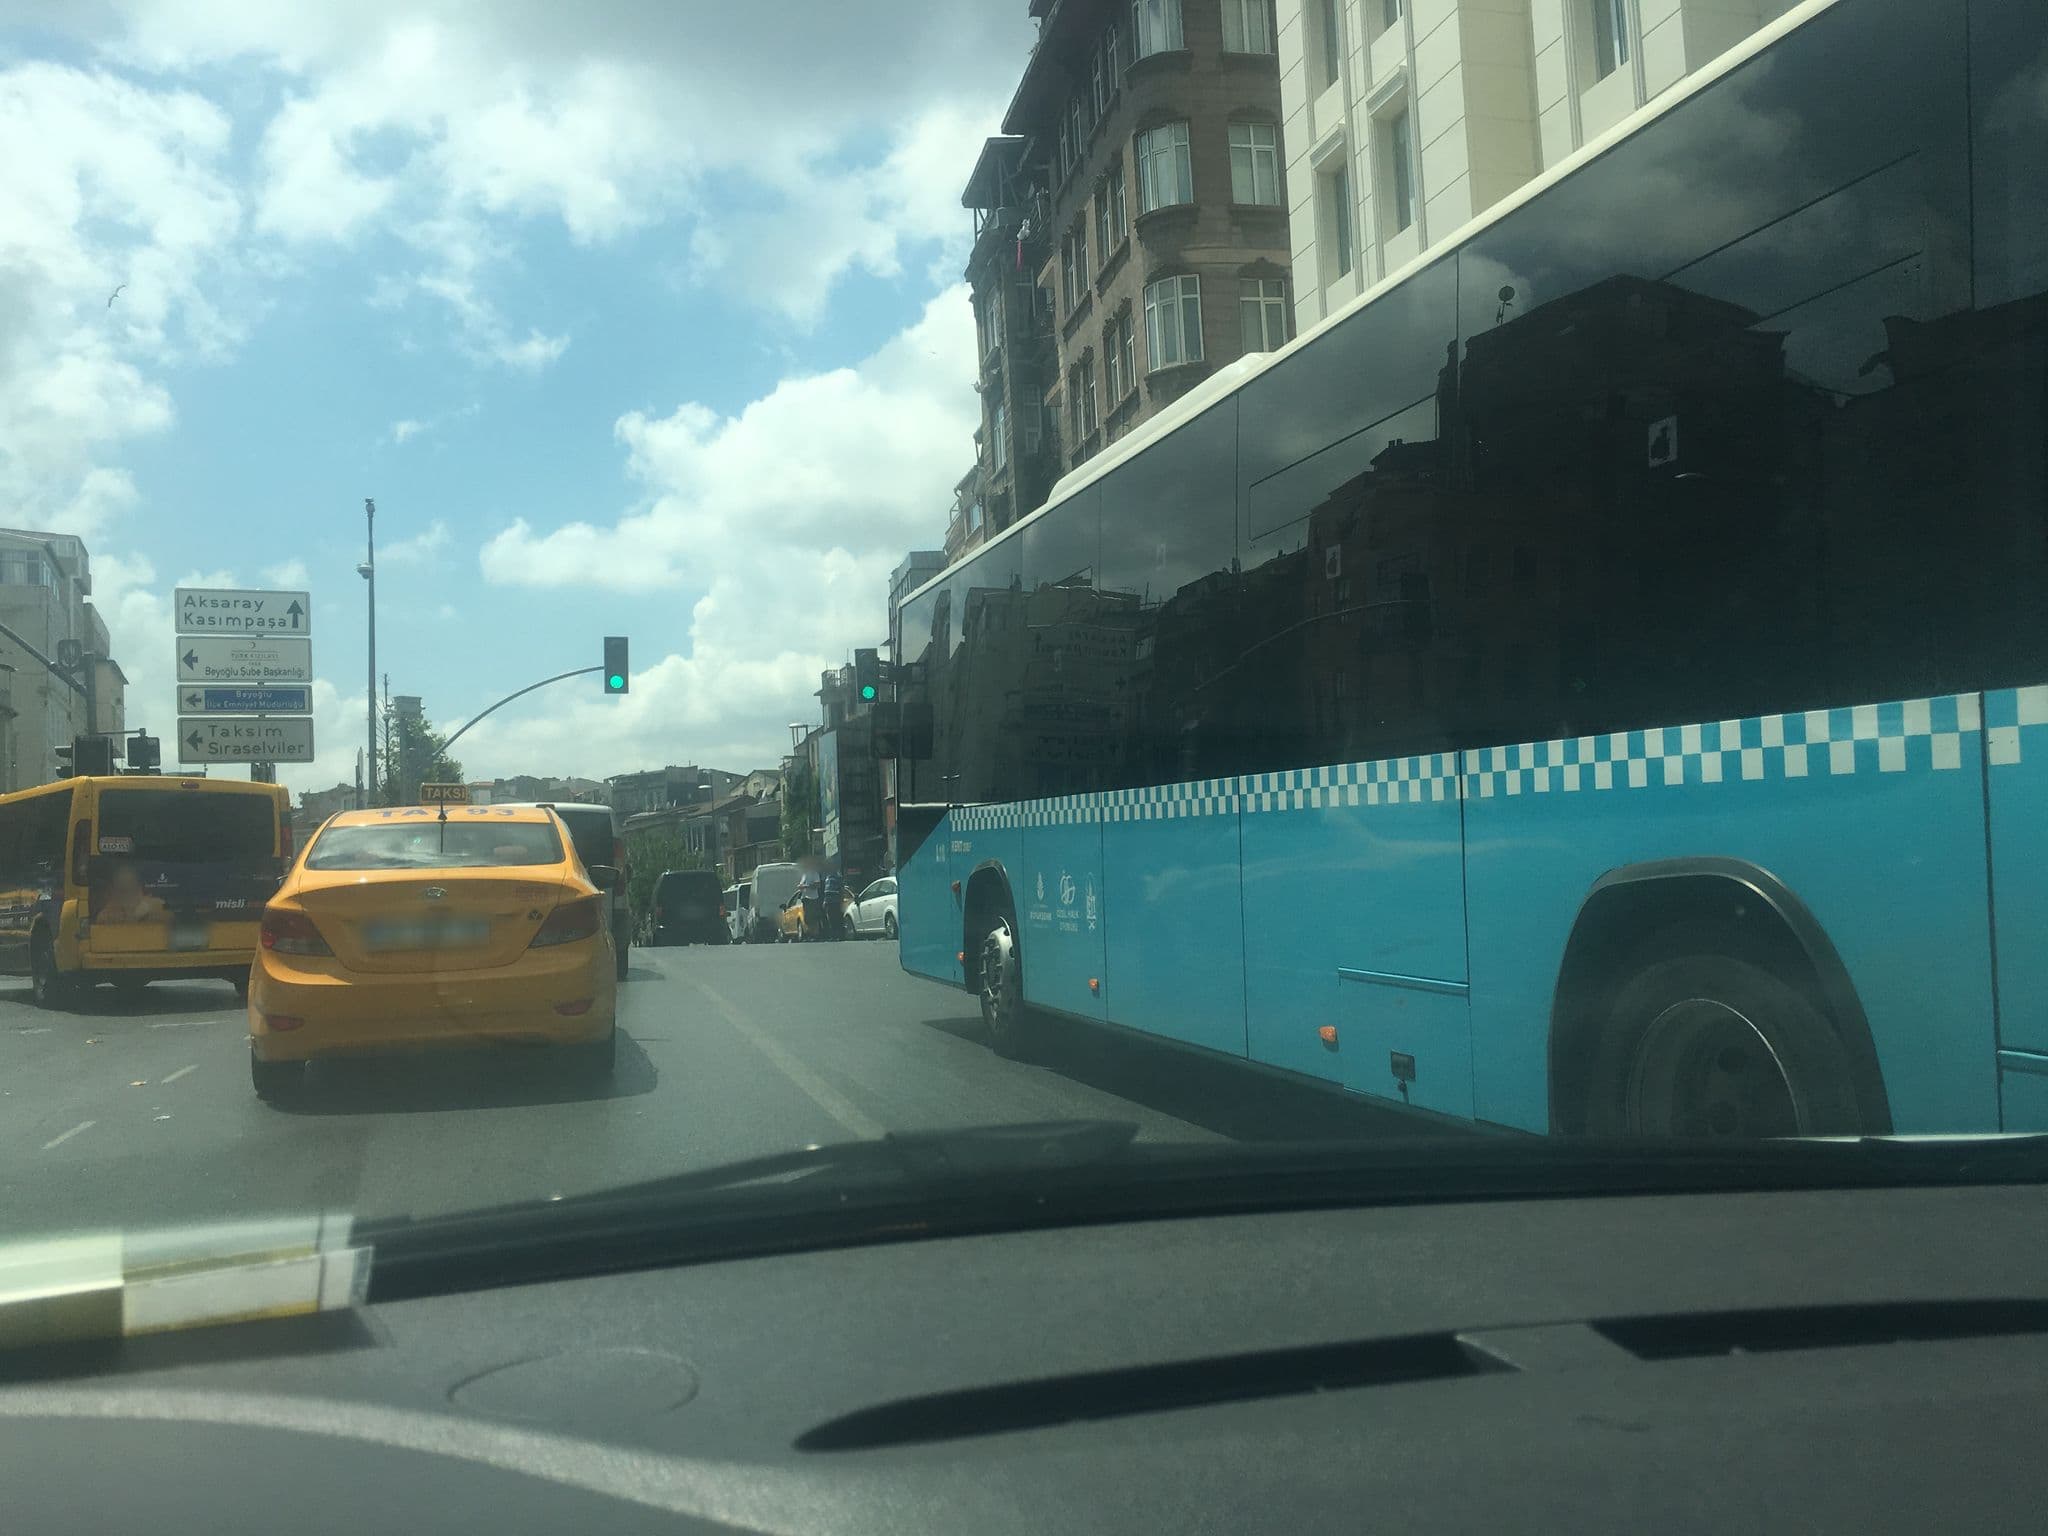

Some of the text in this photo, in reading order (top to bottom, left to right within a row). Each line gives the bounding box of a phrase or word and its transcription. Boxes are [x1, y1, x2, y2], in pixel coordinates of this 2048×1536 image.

[183, 595, 264, 612] Aksaray
[184, 612, 287, 629] Kasımpaşa
[240, 666, 260, 677] Şube
[208, 724, 282, 738] Taksim
[208, 742, 304, 755] Sıraselviler
[215, 898, 246, 909] misli
